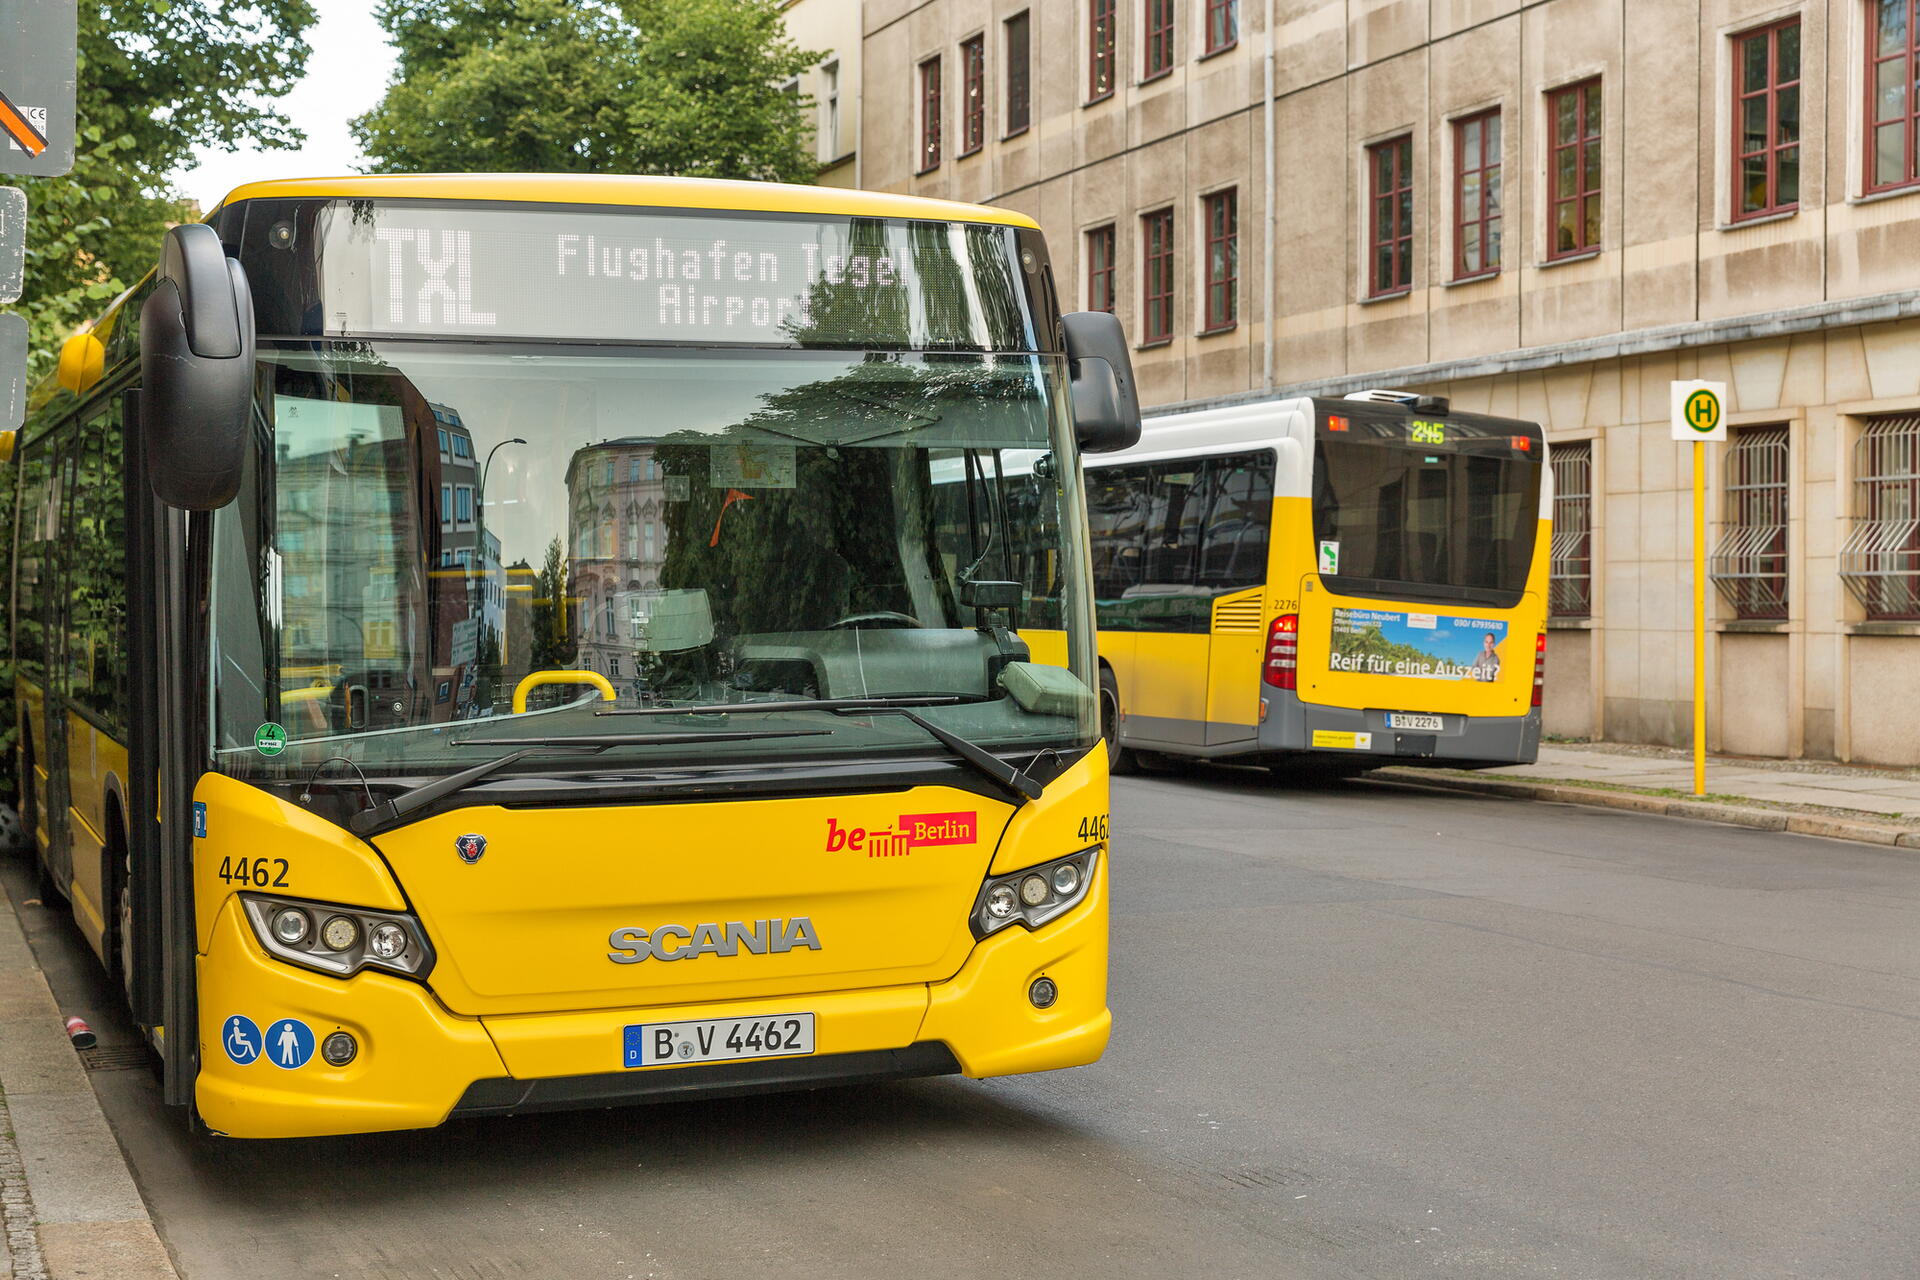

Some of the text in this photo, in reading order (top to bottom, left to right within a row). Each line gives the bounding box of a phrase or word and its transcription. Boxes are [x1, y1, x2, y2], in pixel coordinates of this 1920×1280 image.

[558, 234, 907, 287] Flughafen Tegel
[376, 228, 497, 325] TXL
[659, 284, 815, 328] Airport
[1695, 399, 1712, 423] H
[1412, 420, 1445, 444] 245
[1274, 599, 1298, 611] 2276
[1330, 652, 1500, 681] Reif für eine Auszeit?
[265, 725, 276, 739] 4
[1394, 715, 1402, 727] B
[1414, 716, 1439, 729] 2276
[826, 818, 970, 852] be Berlin
[218, 855, 289, 888] 4462
[607, 916, 822, 964] SCANIA
[654, 1018, 802, 1060] B V 4462
[629, 1050, 638, 1060] D
